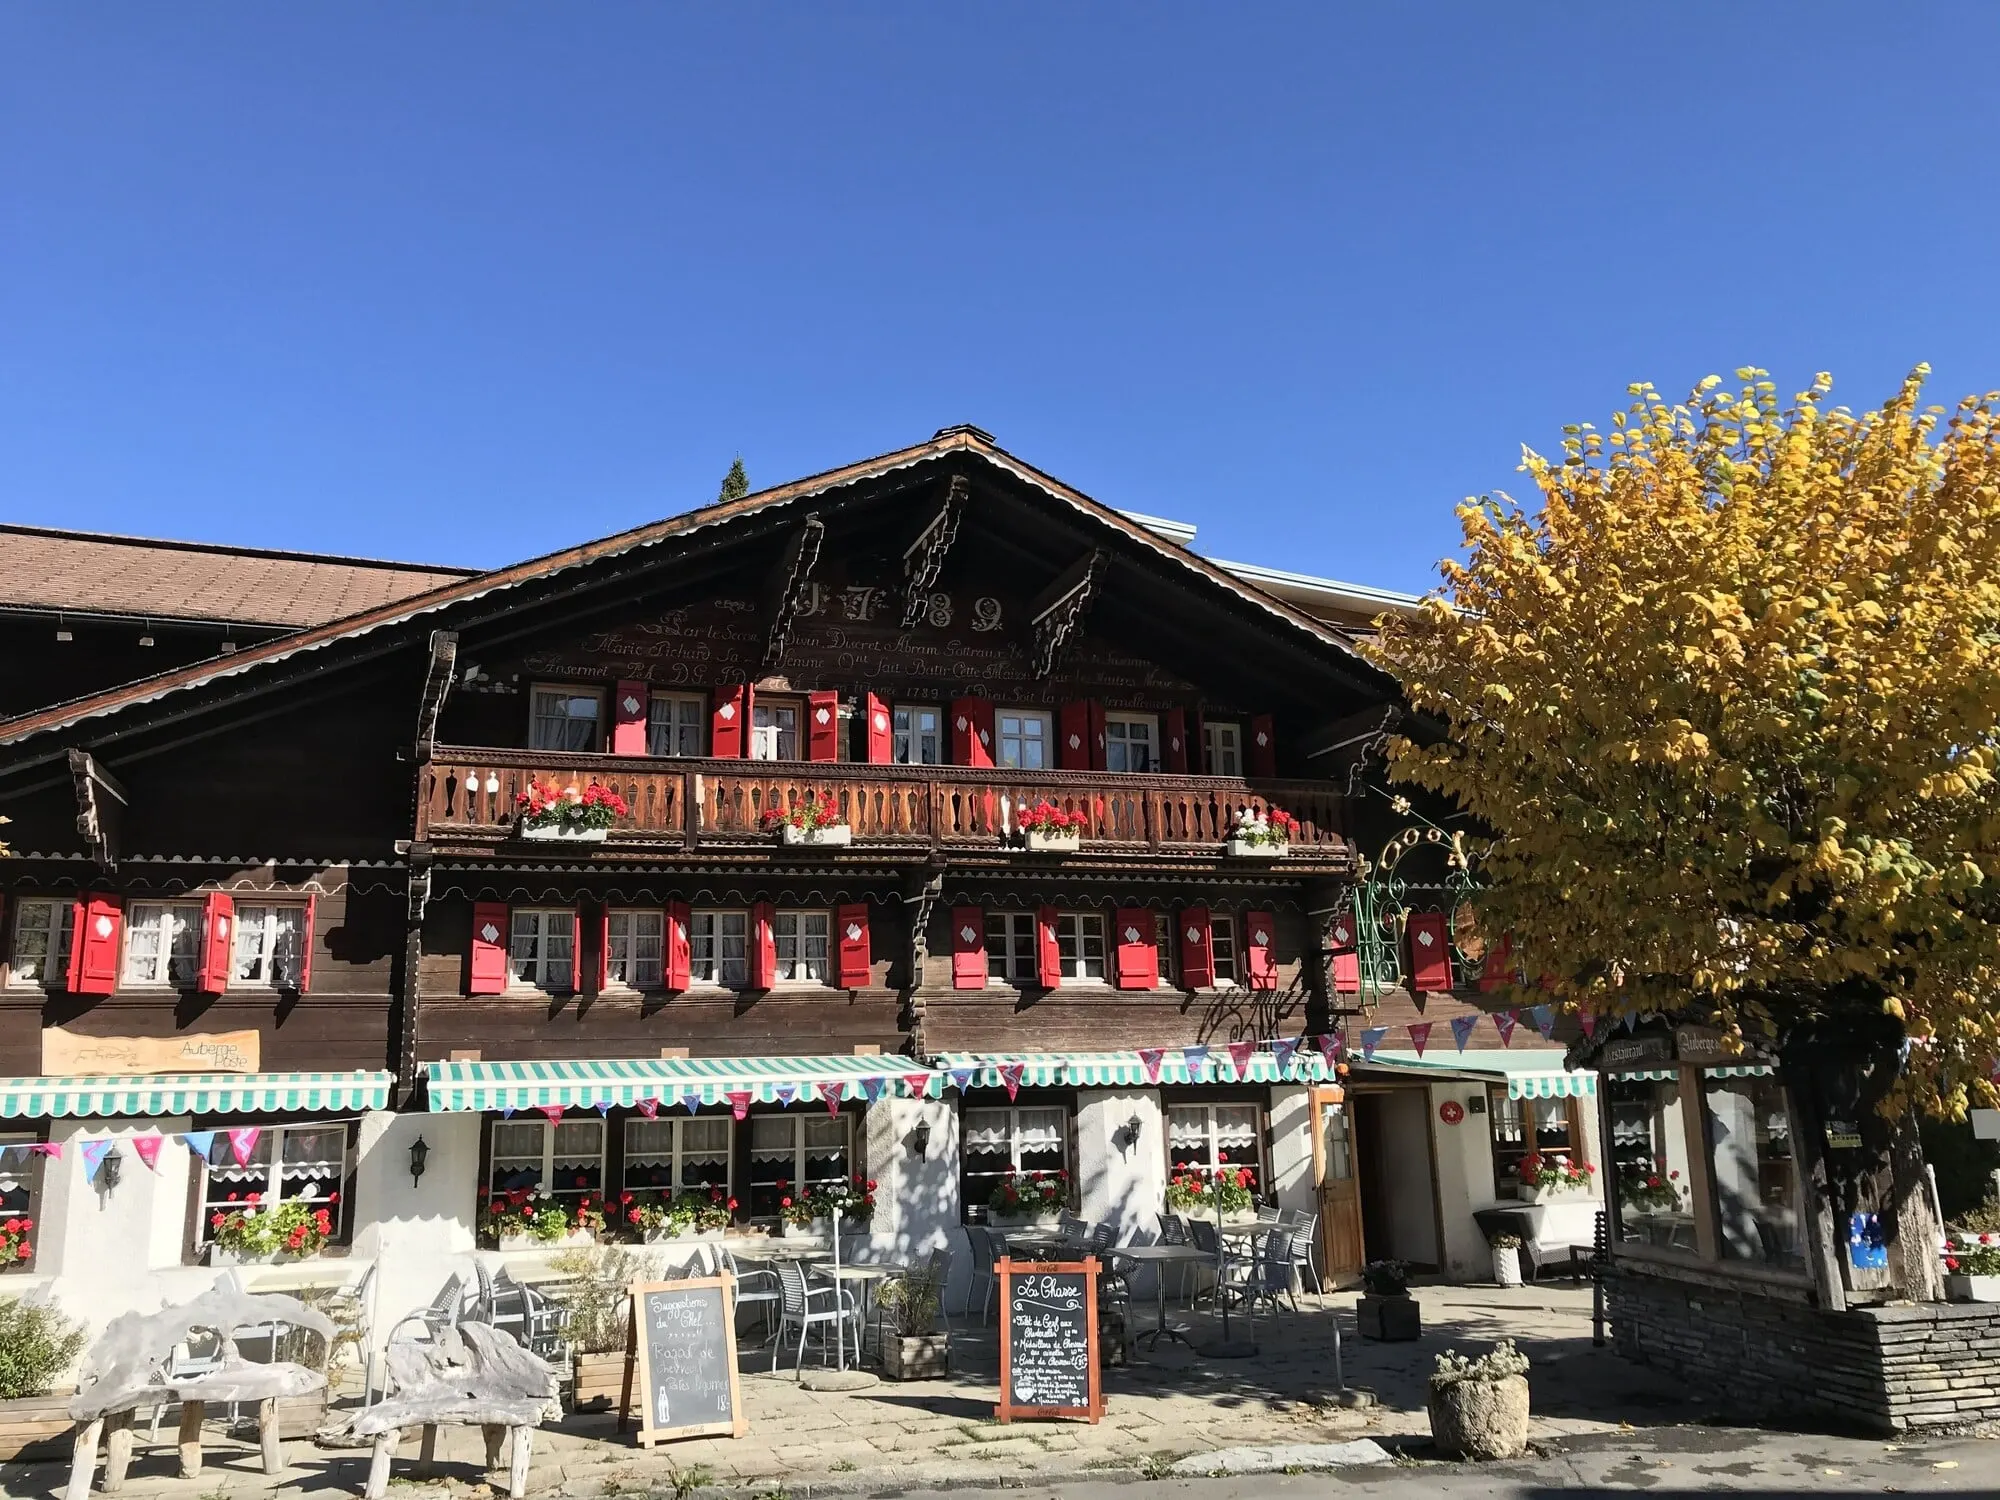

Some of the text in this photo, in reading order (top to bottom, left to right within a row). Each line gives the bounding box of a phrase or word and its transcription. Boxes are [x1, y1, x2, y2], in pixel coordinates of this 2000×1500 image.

[1679, 1032, 1715, 1054] Auberge
[1017, 1275, 1082, 1299] La Chasse
[656, 1317, 668, 1329] du
[700, 1340, 716, 1360] de
